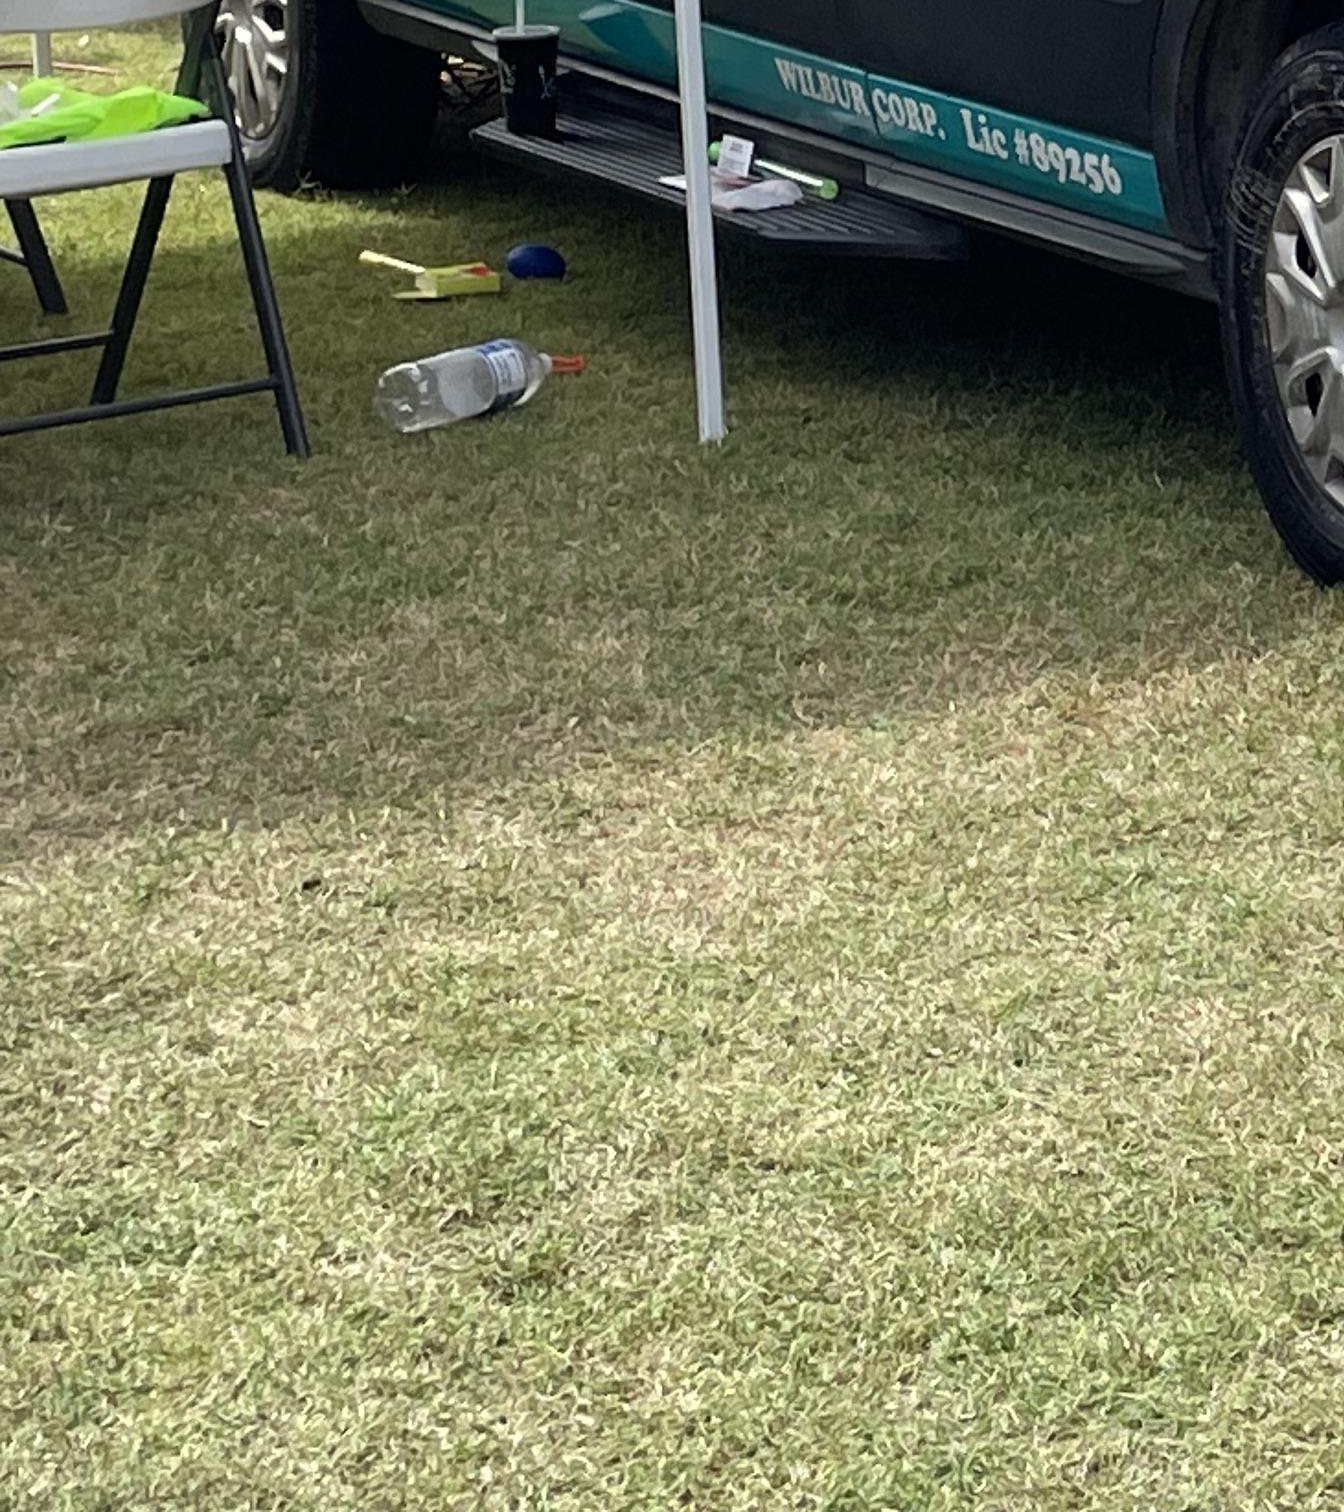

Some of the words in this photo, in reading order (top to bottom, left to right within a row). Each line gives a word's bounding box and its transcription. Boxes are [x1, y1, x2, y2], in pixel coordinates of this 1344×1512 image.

[774, 57, 870, 117] WILBUR
[871, 87, 946, 140] CORP.
[960, 108, 1008, 160] Lic
[1013, 128, 1122, 195] #89256
